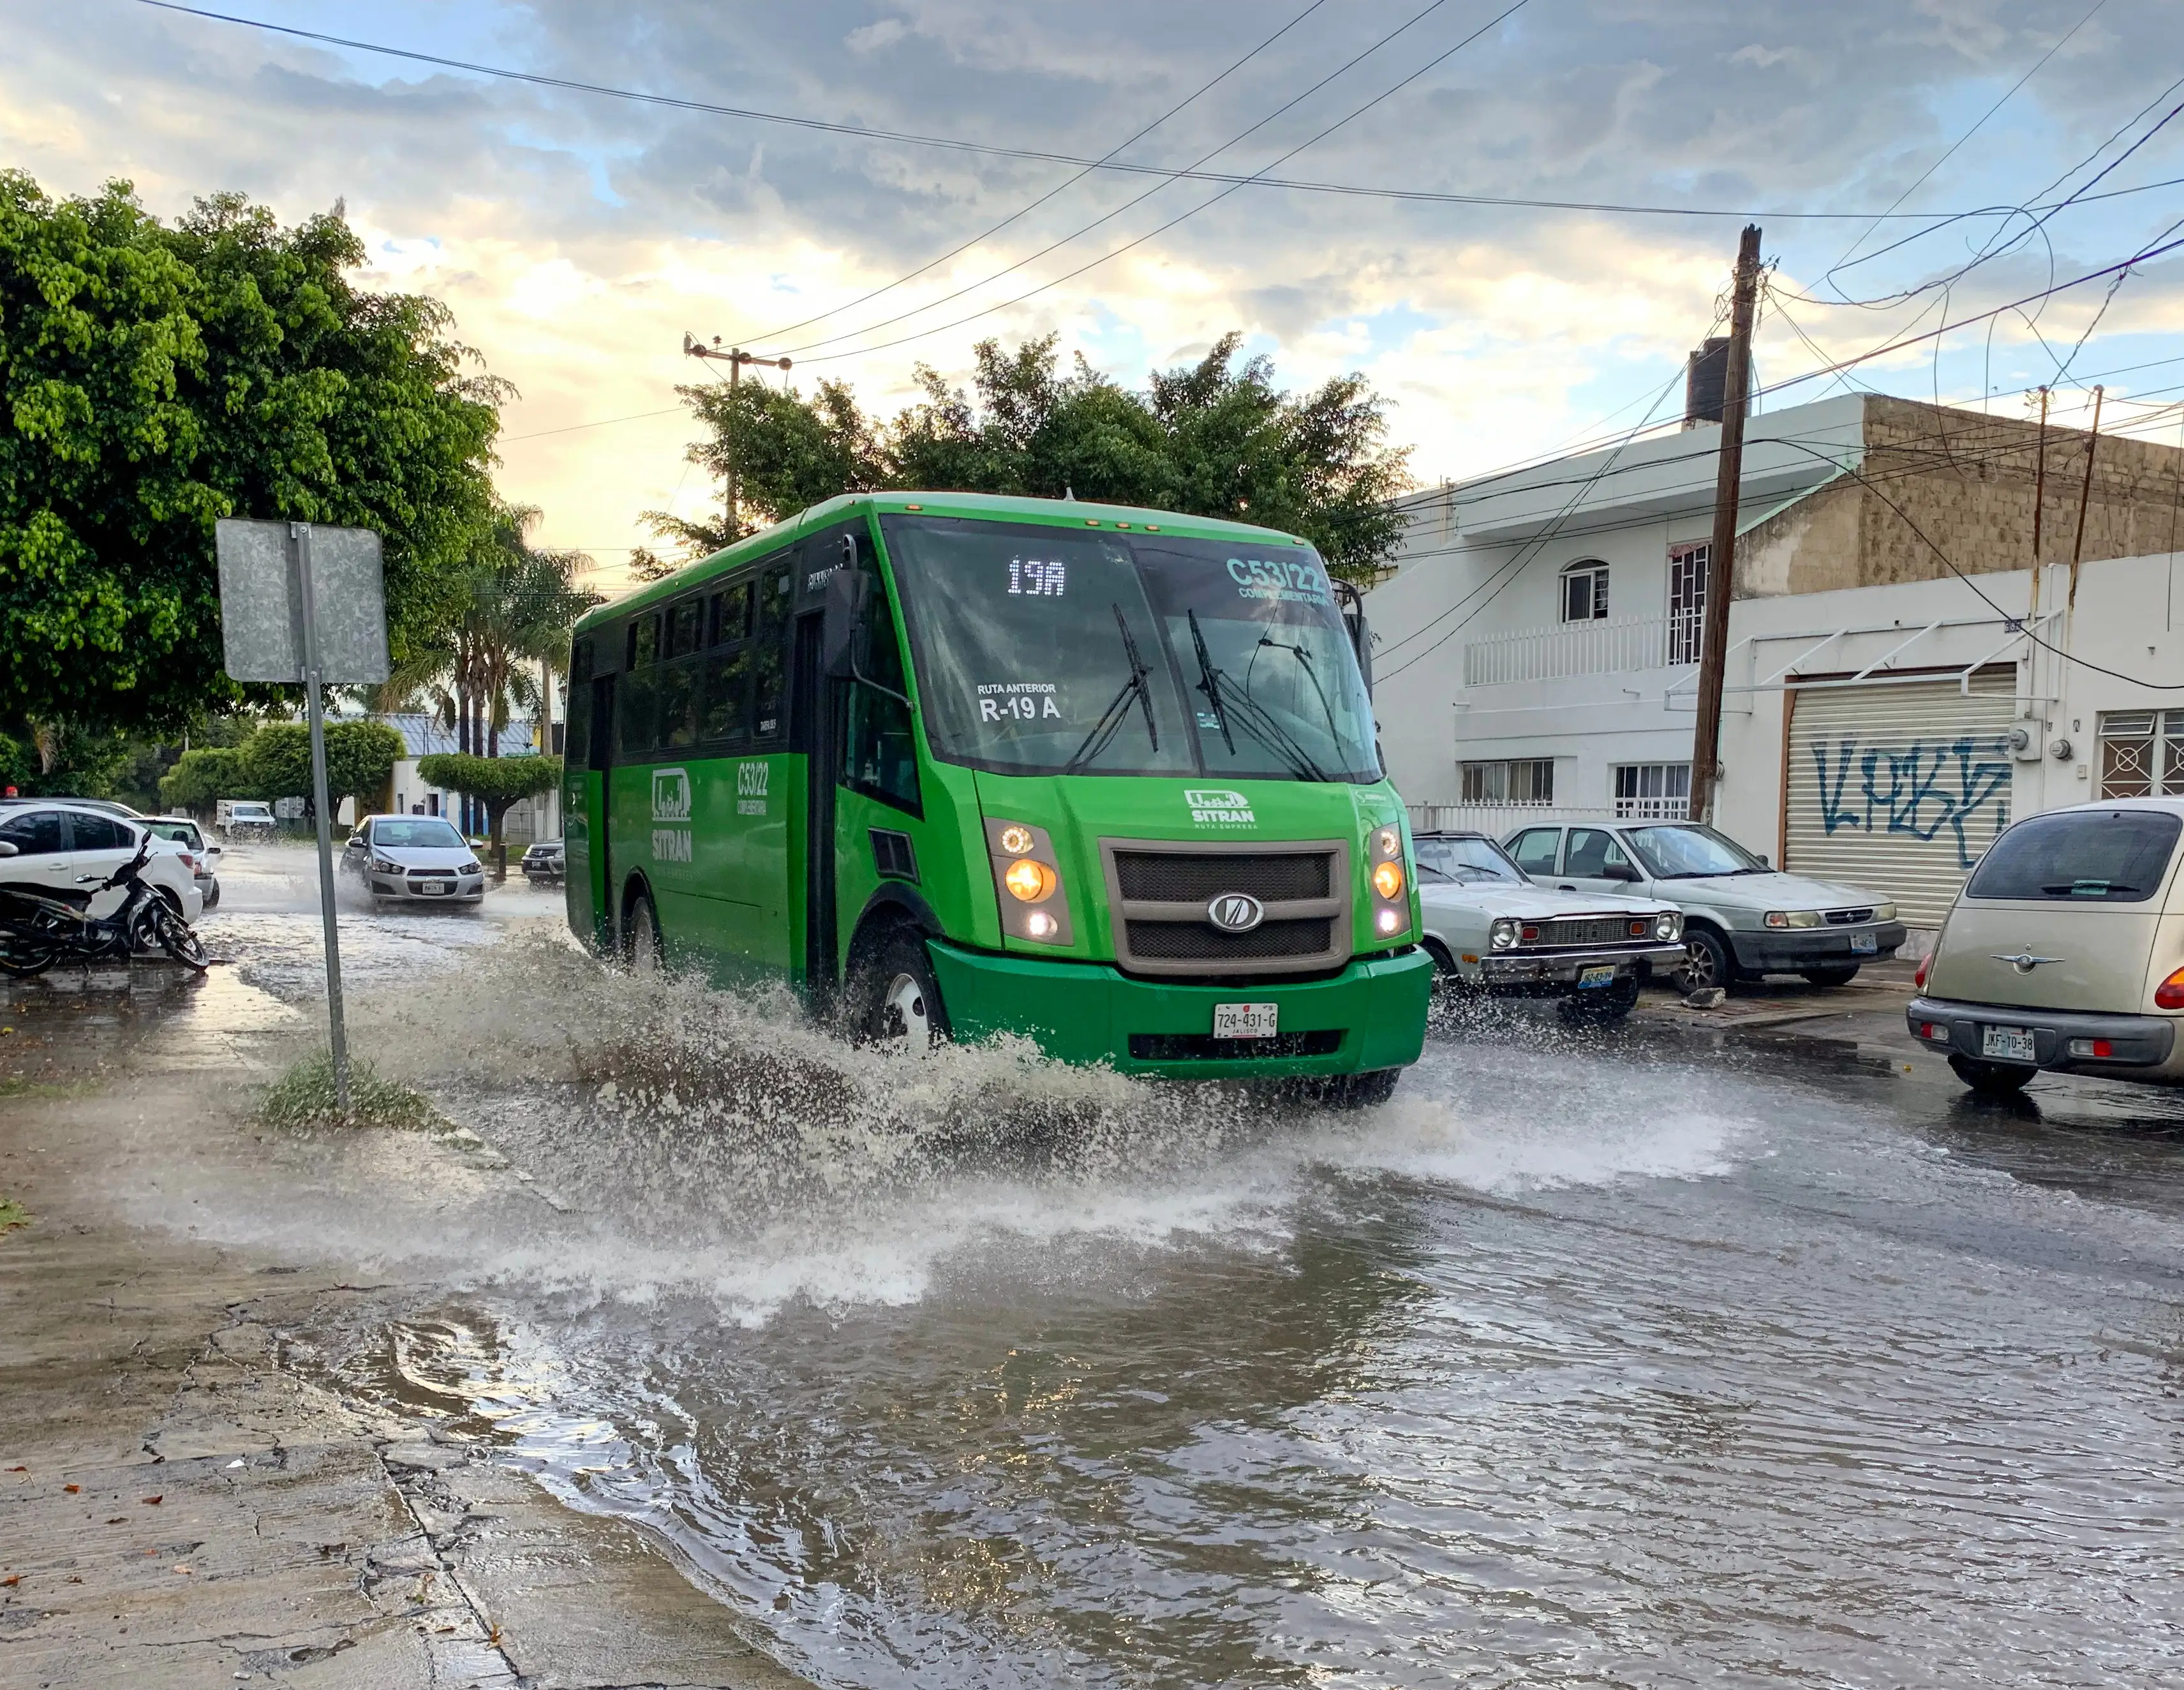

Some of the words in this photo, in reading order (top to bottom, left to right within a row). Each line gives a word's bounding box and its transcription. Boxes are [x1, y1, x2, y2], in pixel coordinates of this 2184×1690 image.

[1007, 560, 1064, 595] 19A
[1226, 558, 1326, 594] C53/22
[977, 684, 1005, 695] RUTA
[1006, 683, 1057, 693] ANTERIOR
[979, 696, 1036, 722] R-19
[1042, 696, 1061, 718] A
[738, 762, 768, 796] C53/22
[1191, 810, 1255, 822] SITRAN
[651, 829, 692, 862] SITRAN
[1217, 1012, 1275, 1028] 724-431-G
[1986, 1033, 2033, 1051] JKF-10-38
